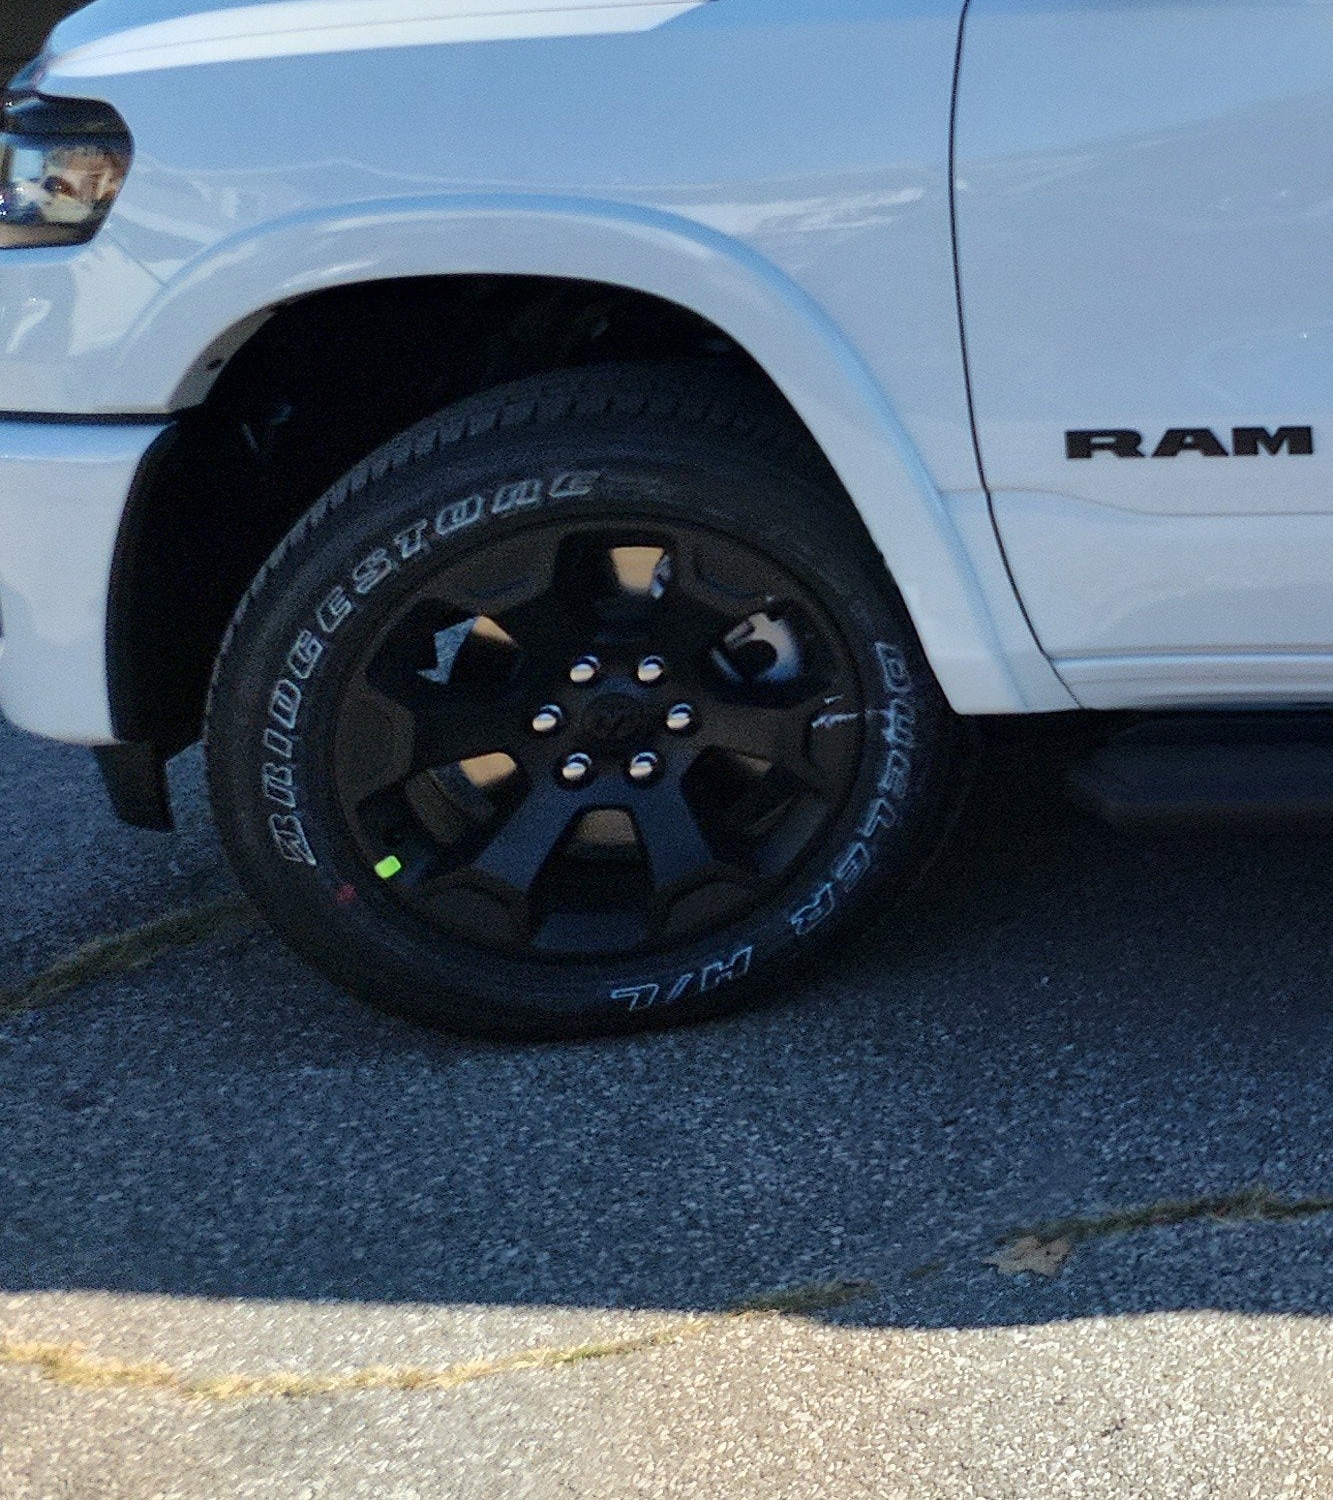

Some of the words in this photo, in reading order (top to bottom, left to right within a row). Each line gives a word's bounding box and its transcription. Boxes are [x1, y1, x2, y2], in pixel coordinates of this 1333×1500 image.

[1065, 425, 1313, 459] RAM
[263, 470, 601, 867] BRIDGESTONE
[790, 642, 916, 936] DUELER
